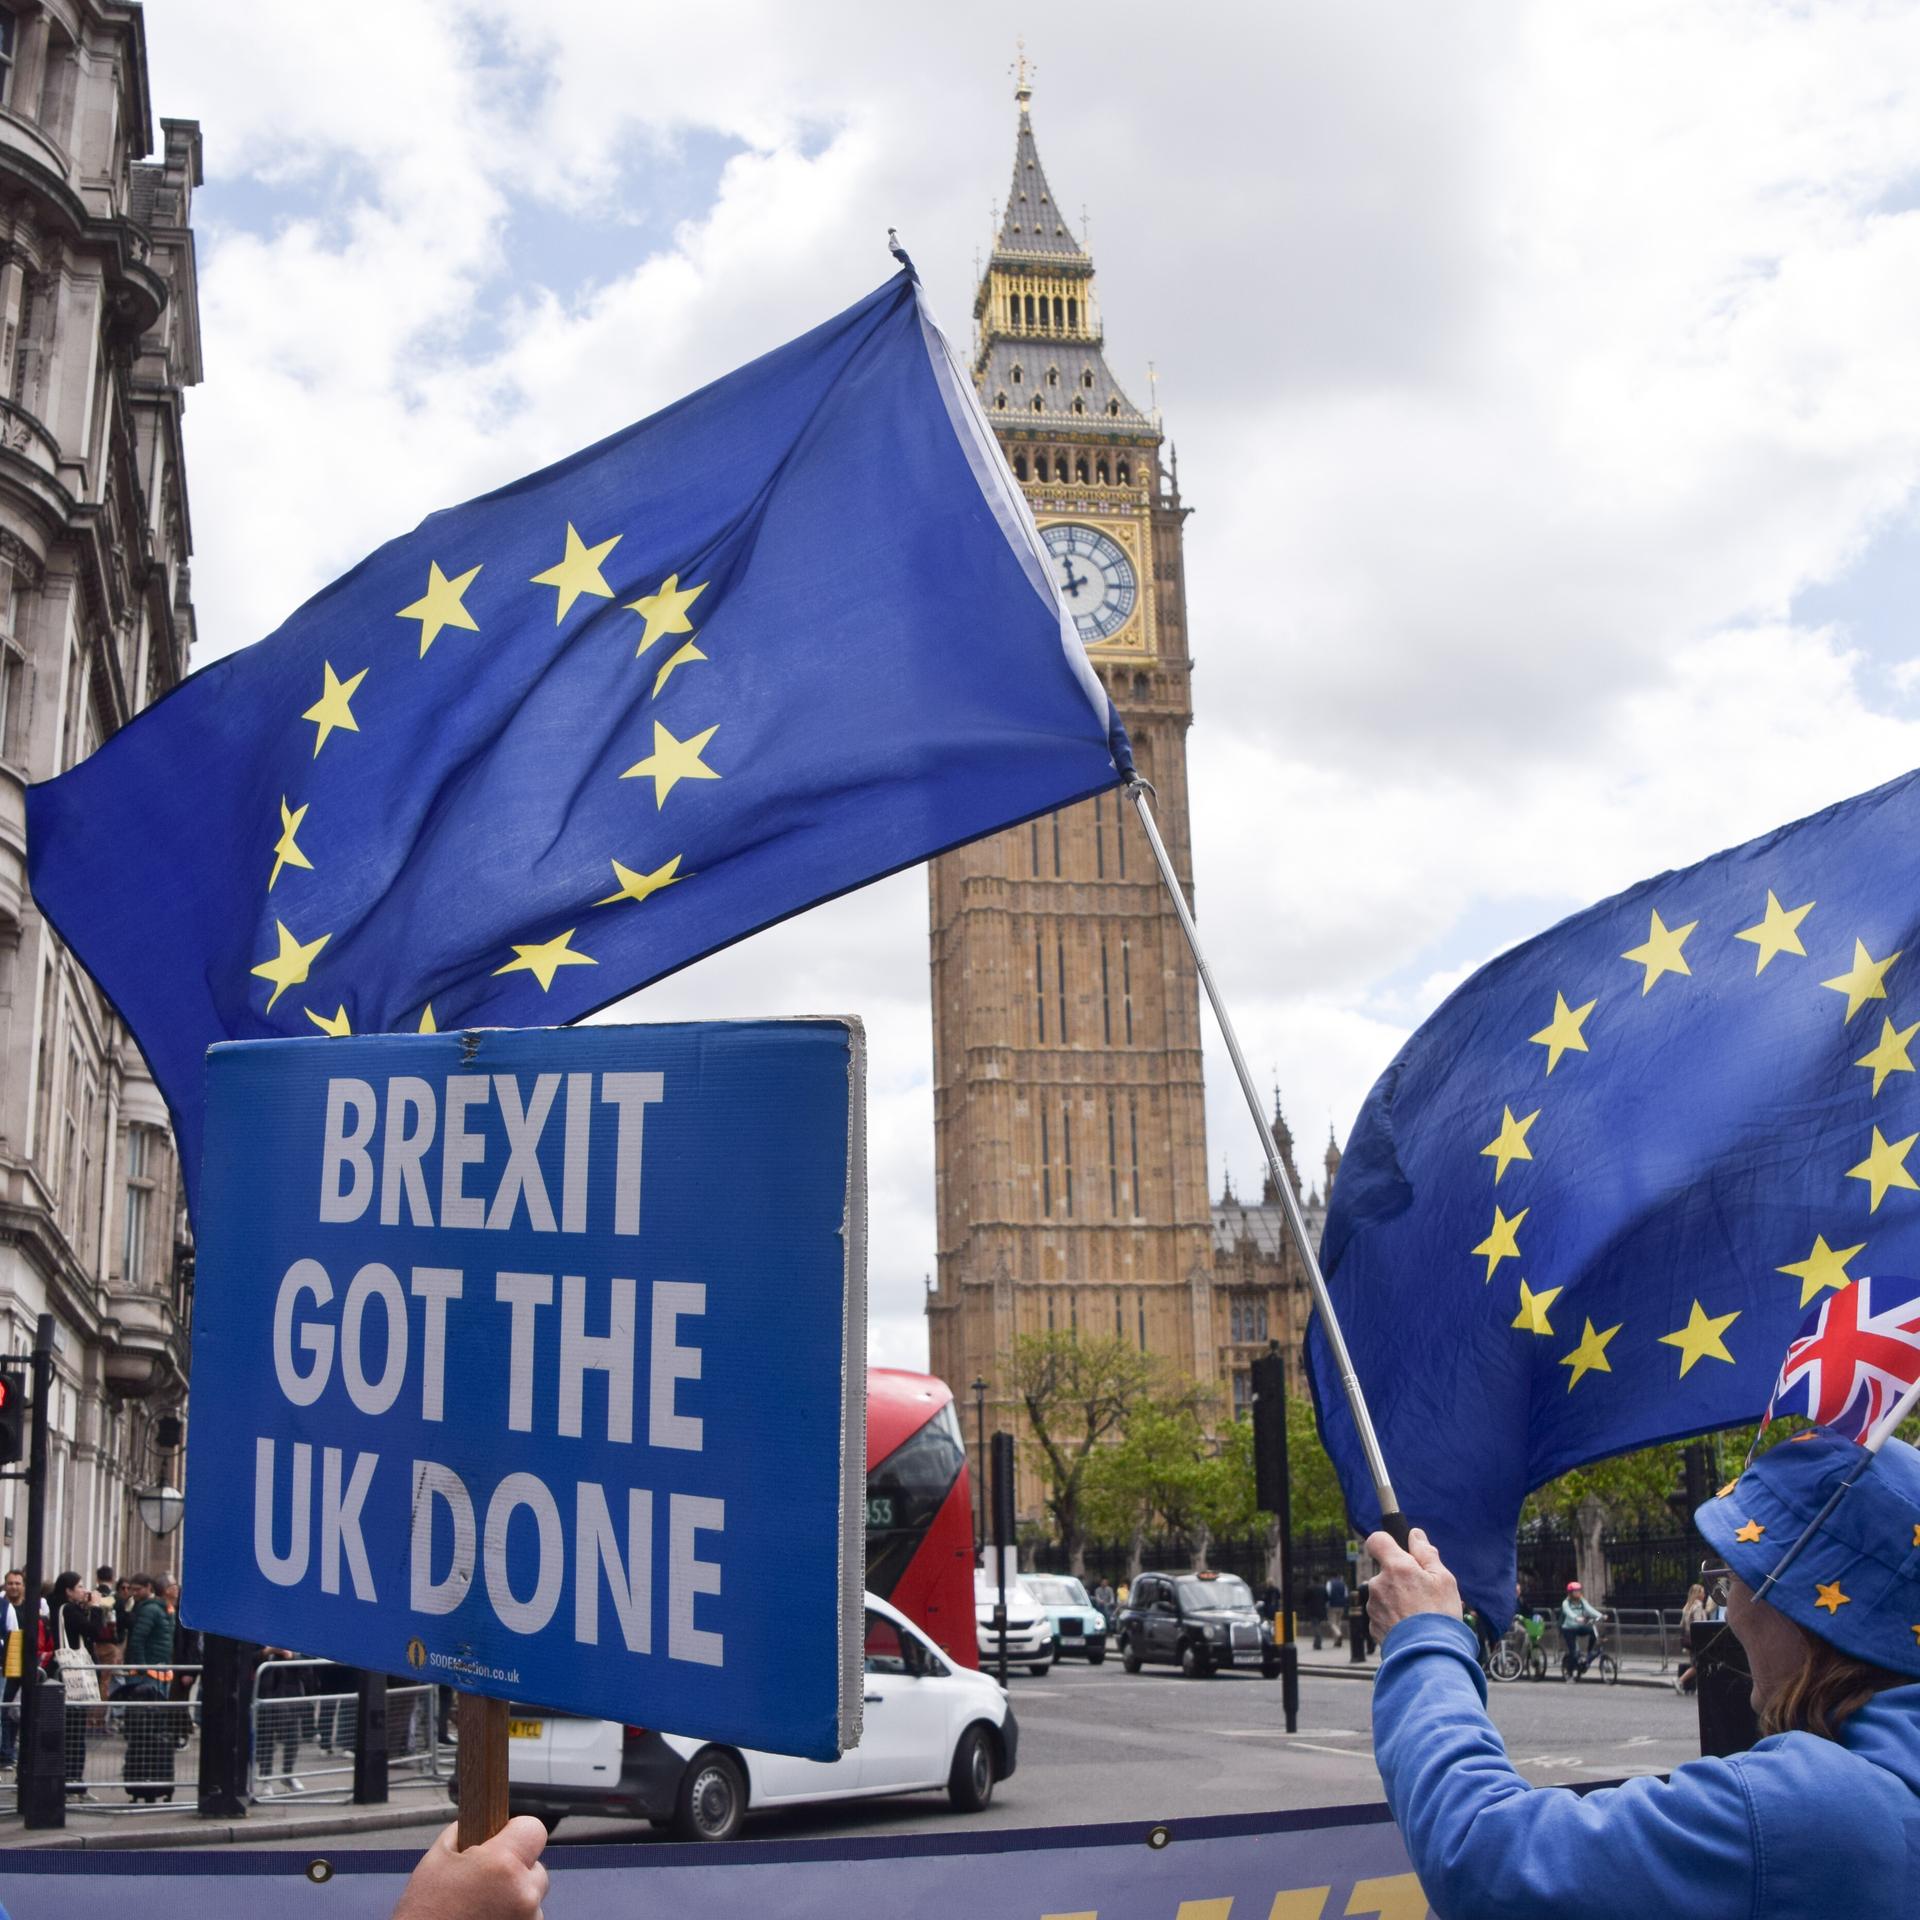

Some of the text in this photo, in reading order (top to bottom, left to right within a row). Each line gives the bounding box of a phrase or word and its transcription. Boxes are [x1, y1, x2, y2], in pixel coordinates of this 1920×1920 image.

[319, 1071, 665, 1236] BREXIT
[273, 1258, 707, 1452] GOT THE
[254, 1437, 725, 1668] UK DONE
